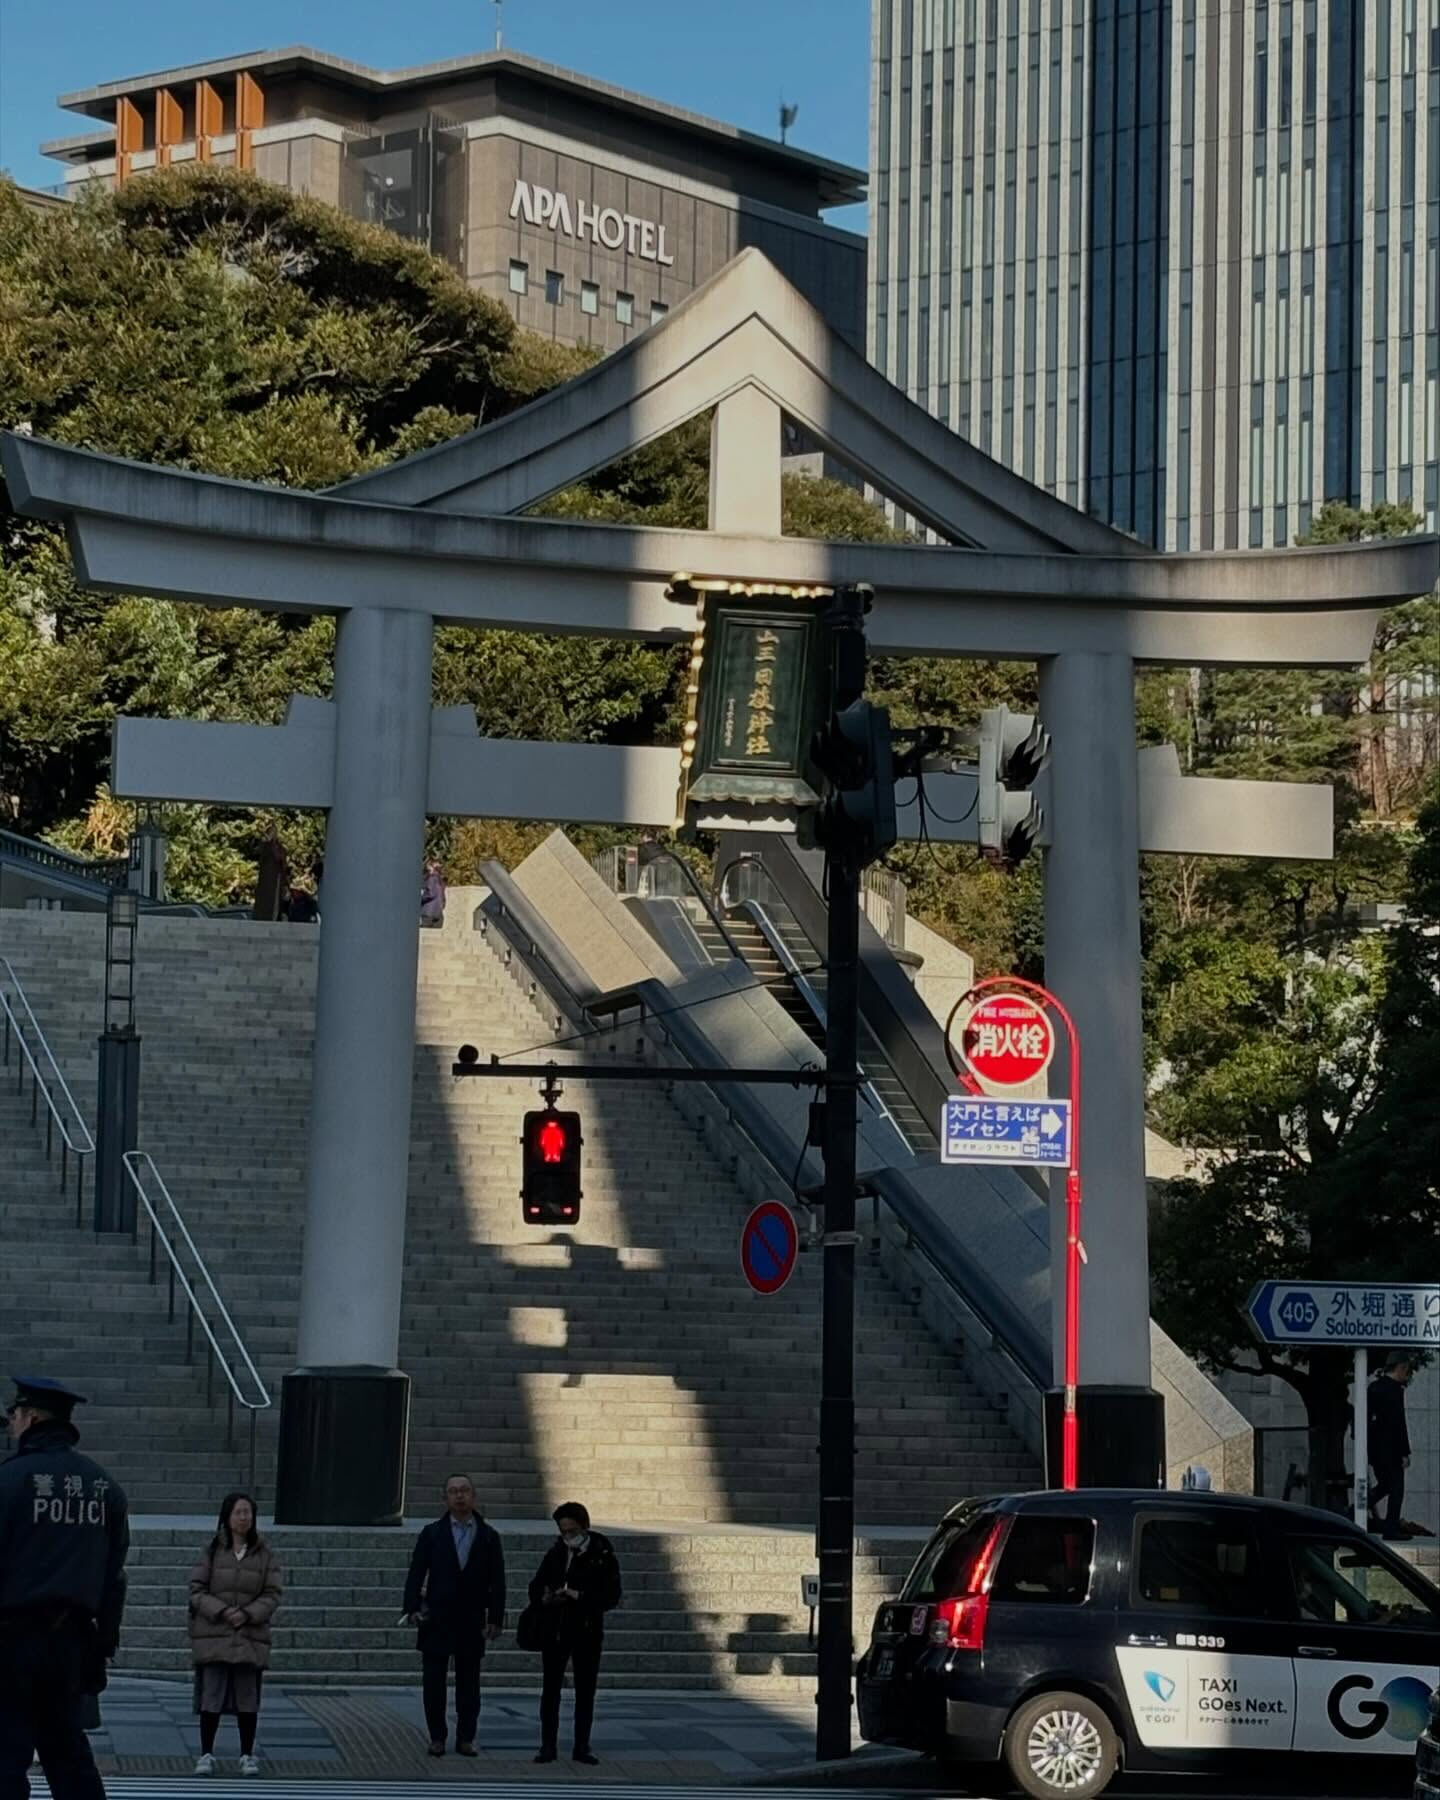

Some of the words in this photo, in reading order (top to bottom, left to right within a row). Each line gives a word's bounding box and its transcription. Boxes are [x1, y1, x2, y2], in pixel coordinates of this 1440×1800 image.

[509, 179, 573, 236] APA
[576, 199, 674, 267] HOTEL
[971, 1022, 1046, 1059] 消火栓
[948, 1103, 1041, 1122] 大門と言えば
[949, 1121, 1010, 1138] ナイセン
[1283, 1302, 1316, 1323] 405
[1325, 1317, 1418, 1337] Sotobori-dori
[33, 1474, 109, 1498] 警視庁
[1199, 1678, 1238, 1693] TAXI
[1199, 1697, 1242, 1712] GOes
[1245, 1698, 1288, 1714] Next.
